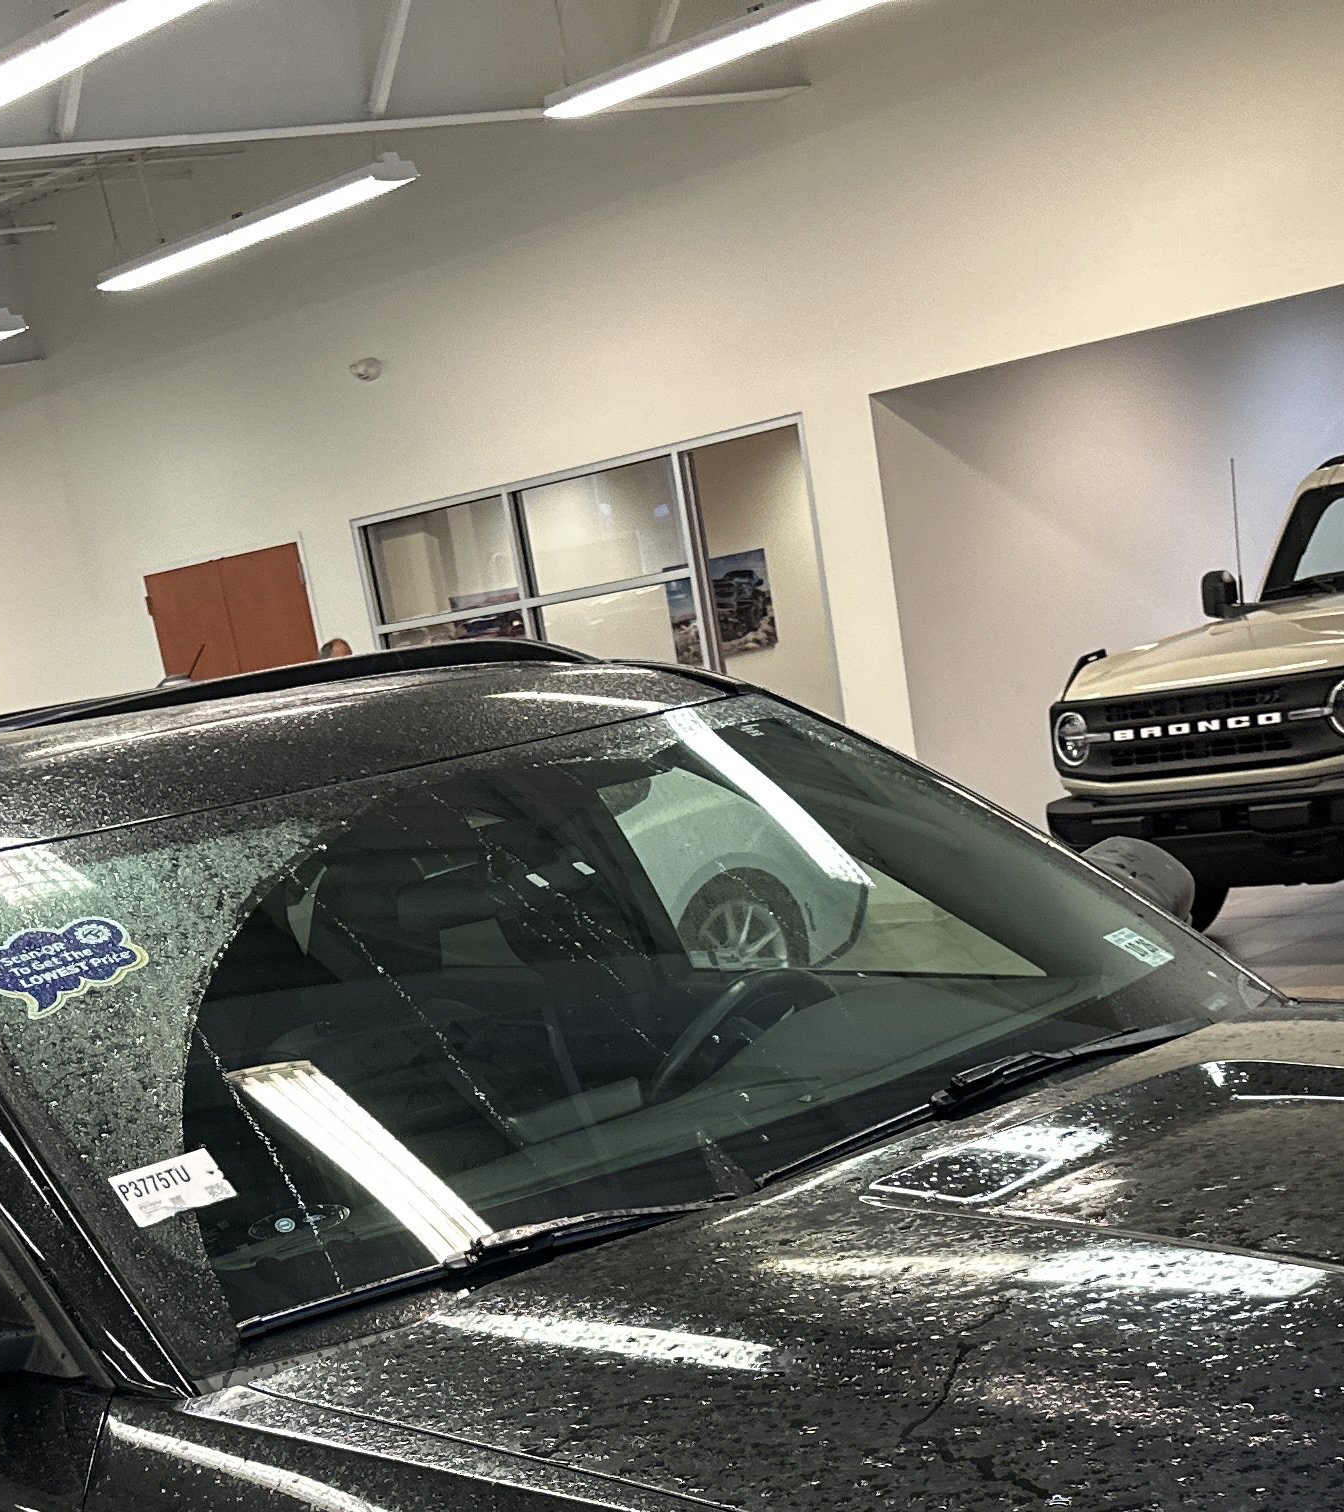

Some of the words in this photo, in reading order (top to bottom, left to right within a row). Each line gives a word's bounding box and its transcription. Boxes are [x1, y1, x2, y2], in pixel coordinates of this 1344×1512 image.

[1113, 711, 1283, 742] BRONCO
[8, 966, 32, 977] To
[32, 956, 63, 970] Get
[61, 948, 94, 962] The
[41, 942, 67, 957] QR
[19, 960, 90, 988] LOWEST
[89, 950, 131, 968] Price
[118, 1165, 191, 1201] P3775TU
